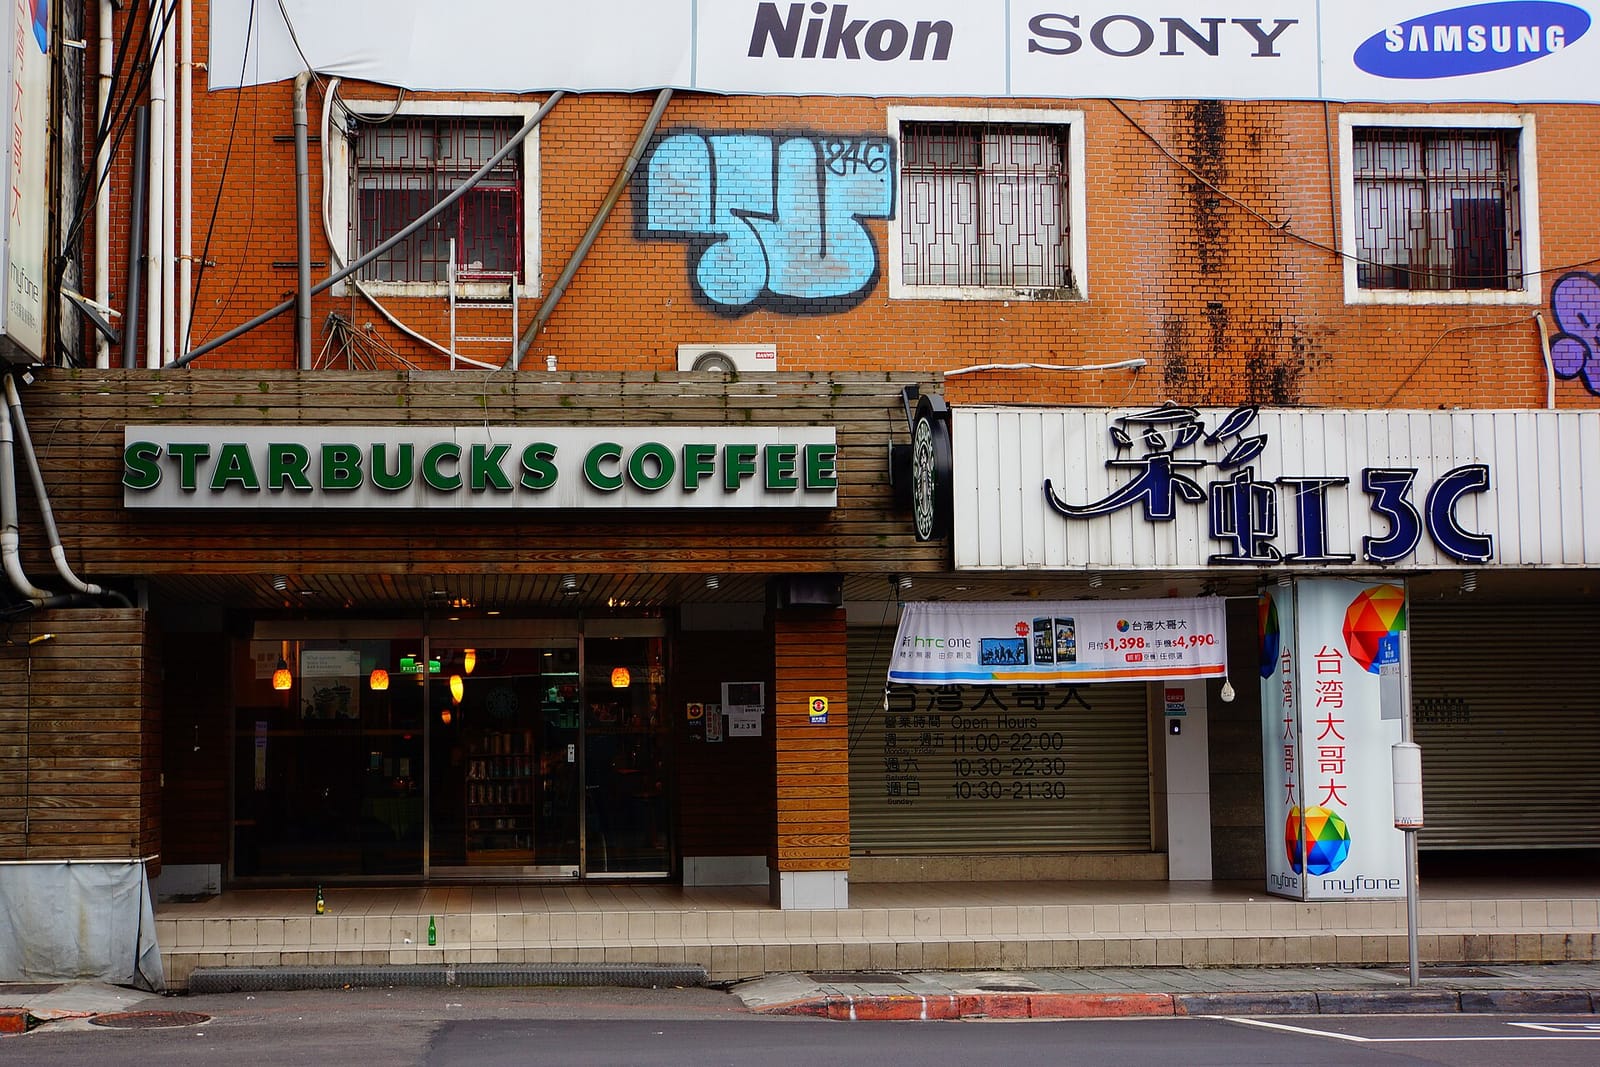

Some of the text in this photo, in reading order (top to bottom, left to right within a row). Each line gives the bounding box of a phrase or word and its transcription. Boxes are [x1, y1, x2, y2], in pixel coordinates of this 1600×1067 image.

[747, 2, 954, 61] Nikon
[1028, 14, 1299, 57] SONY
[1385, 25, 1565, 52] SAMSUNG
[10, 262, 38, 303] myfone
[122, 441, 838, 491] STARBUCKS COFFEE
[948, 637, 971, 648] one
[951, 715, 989, 731] Open
[998, 714, 1038, 728] Hours
[951, 732, 1064, 752] 11:00~22:00
[952, 757, 1066, 777] 10:30~22:30
[952, 781, 1066, 800] 10:30~21:30
[1270, 873, 1298, 891] myfone
[1323, 874, 1400, 894] myfone
